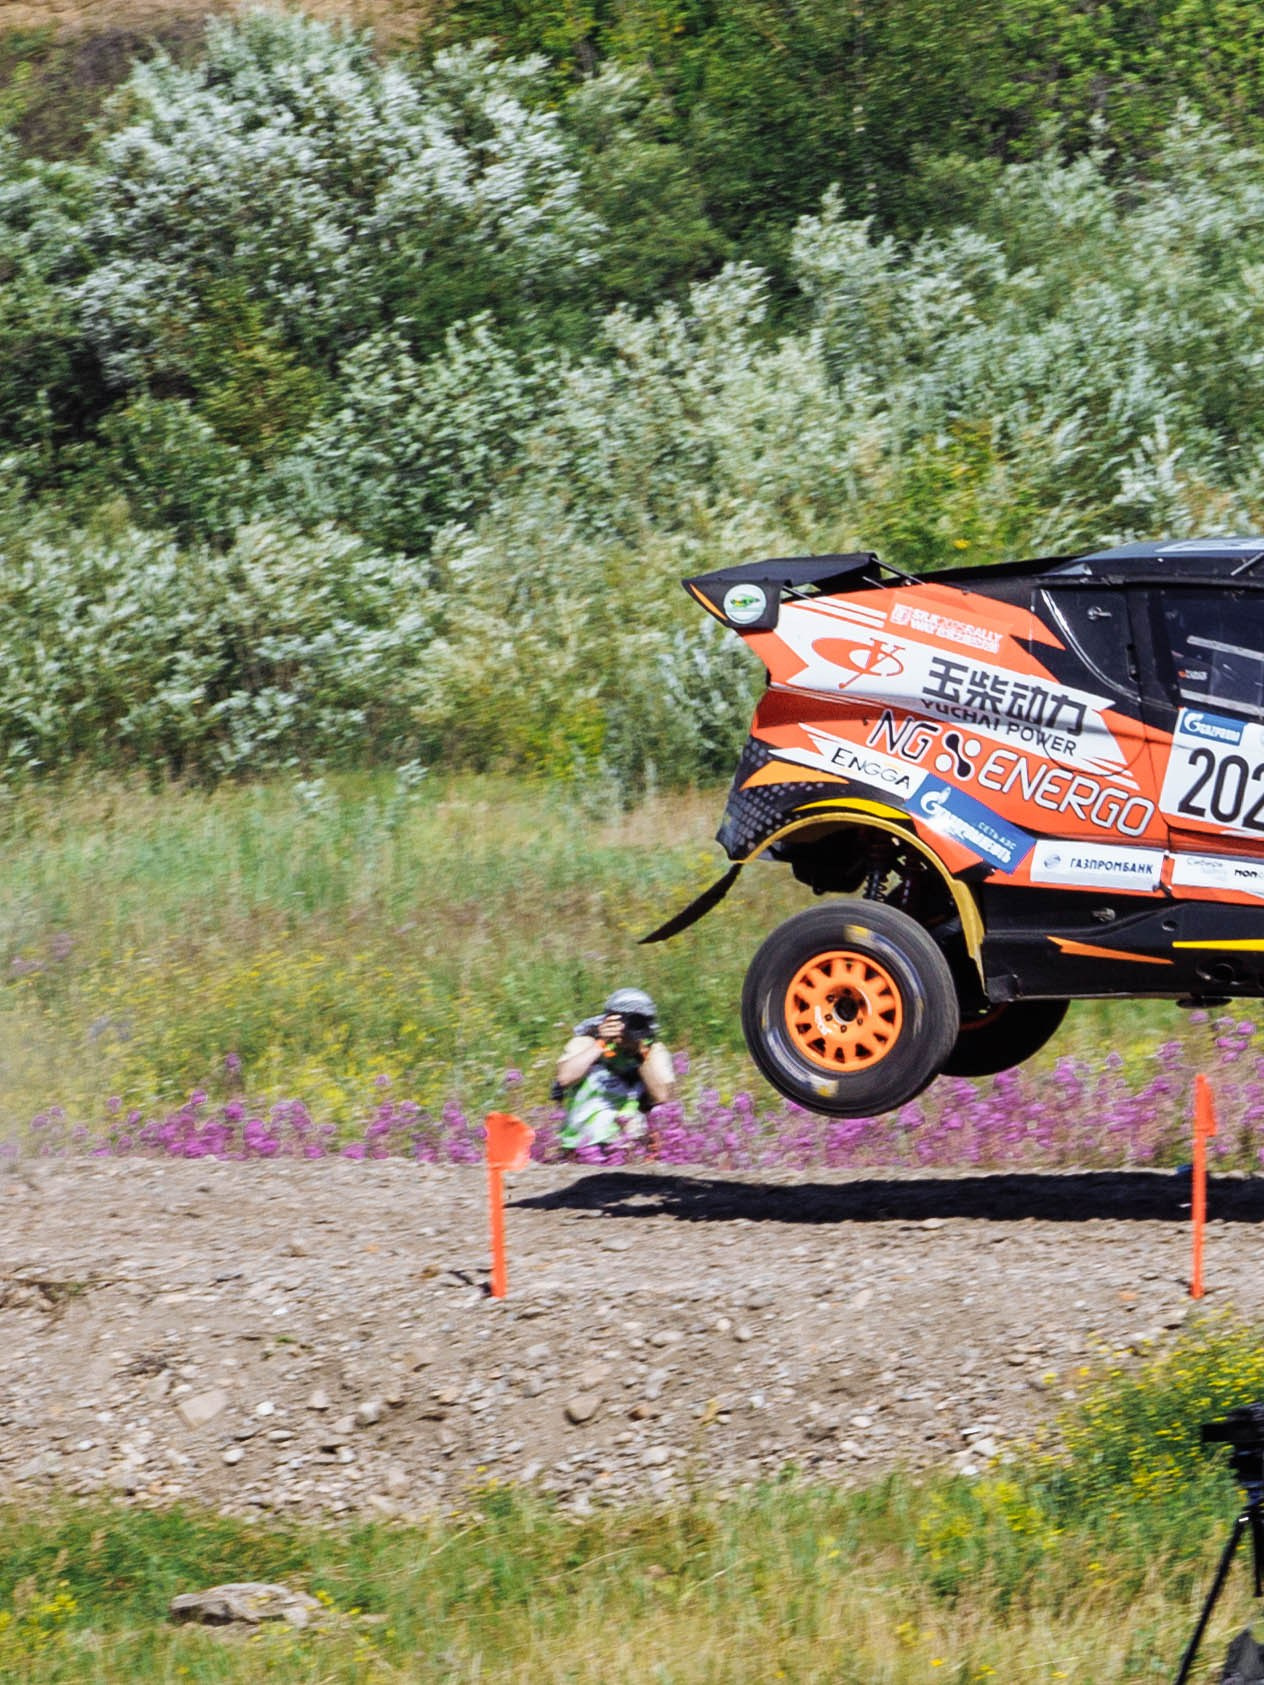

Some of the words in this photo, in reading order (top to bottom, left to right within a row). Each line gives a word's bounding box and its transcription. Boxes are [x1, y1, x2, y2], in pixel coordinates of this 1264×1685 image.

[922, 656, 1087, 736] 玉柴动力
[920, 698, 1000, 731] YUCHAI
[1006, 722, 1077, 756] POWER
[831, 747, 910, 789] ENGGA
[866, 708, 940, 764] NG
[977, 749, 1156, 837] ENERGO
[1070, 857, 1154, 875] ГАЗПРОМБАНК
